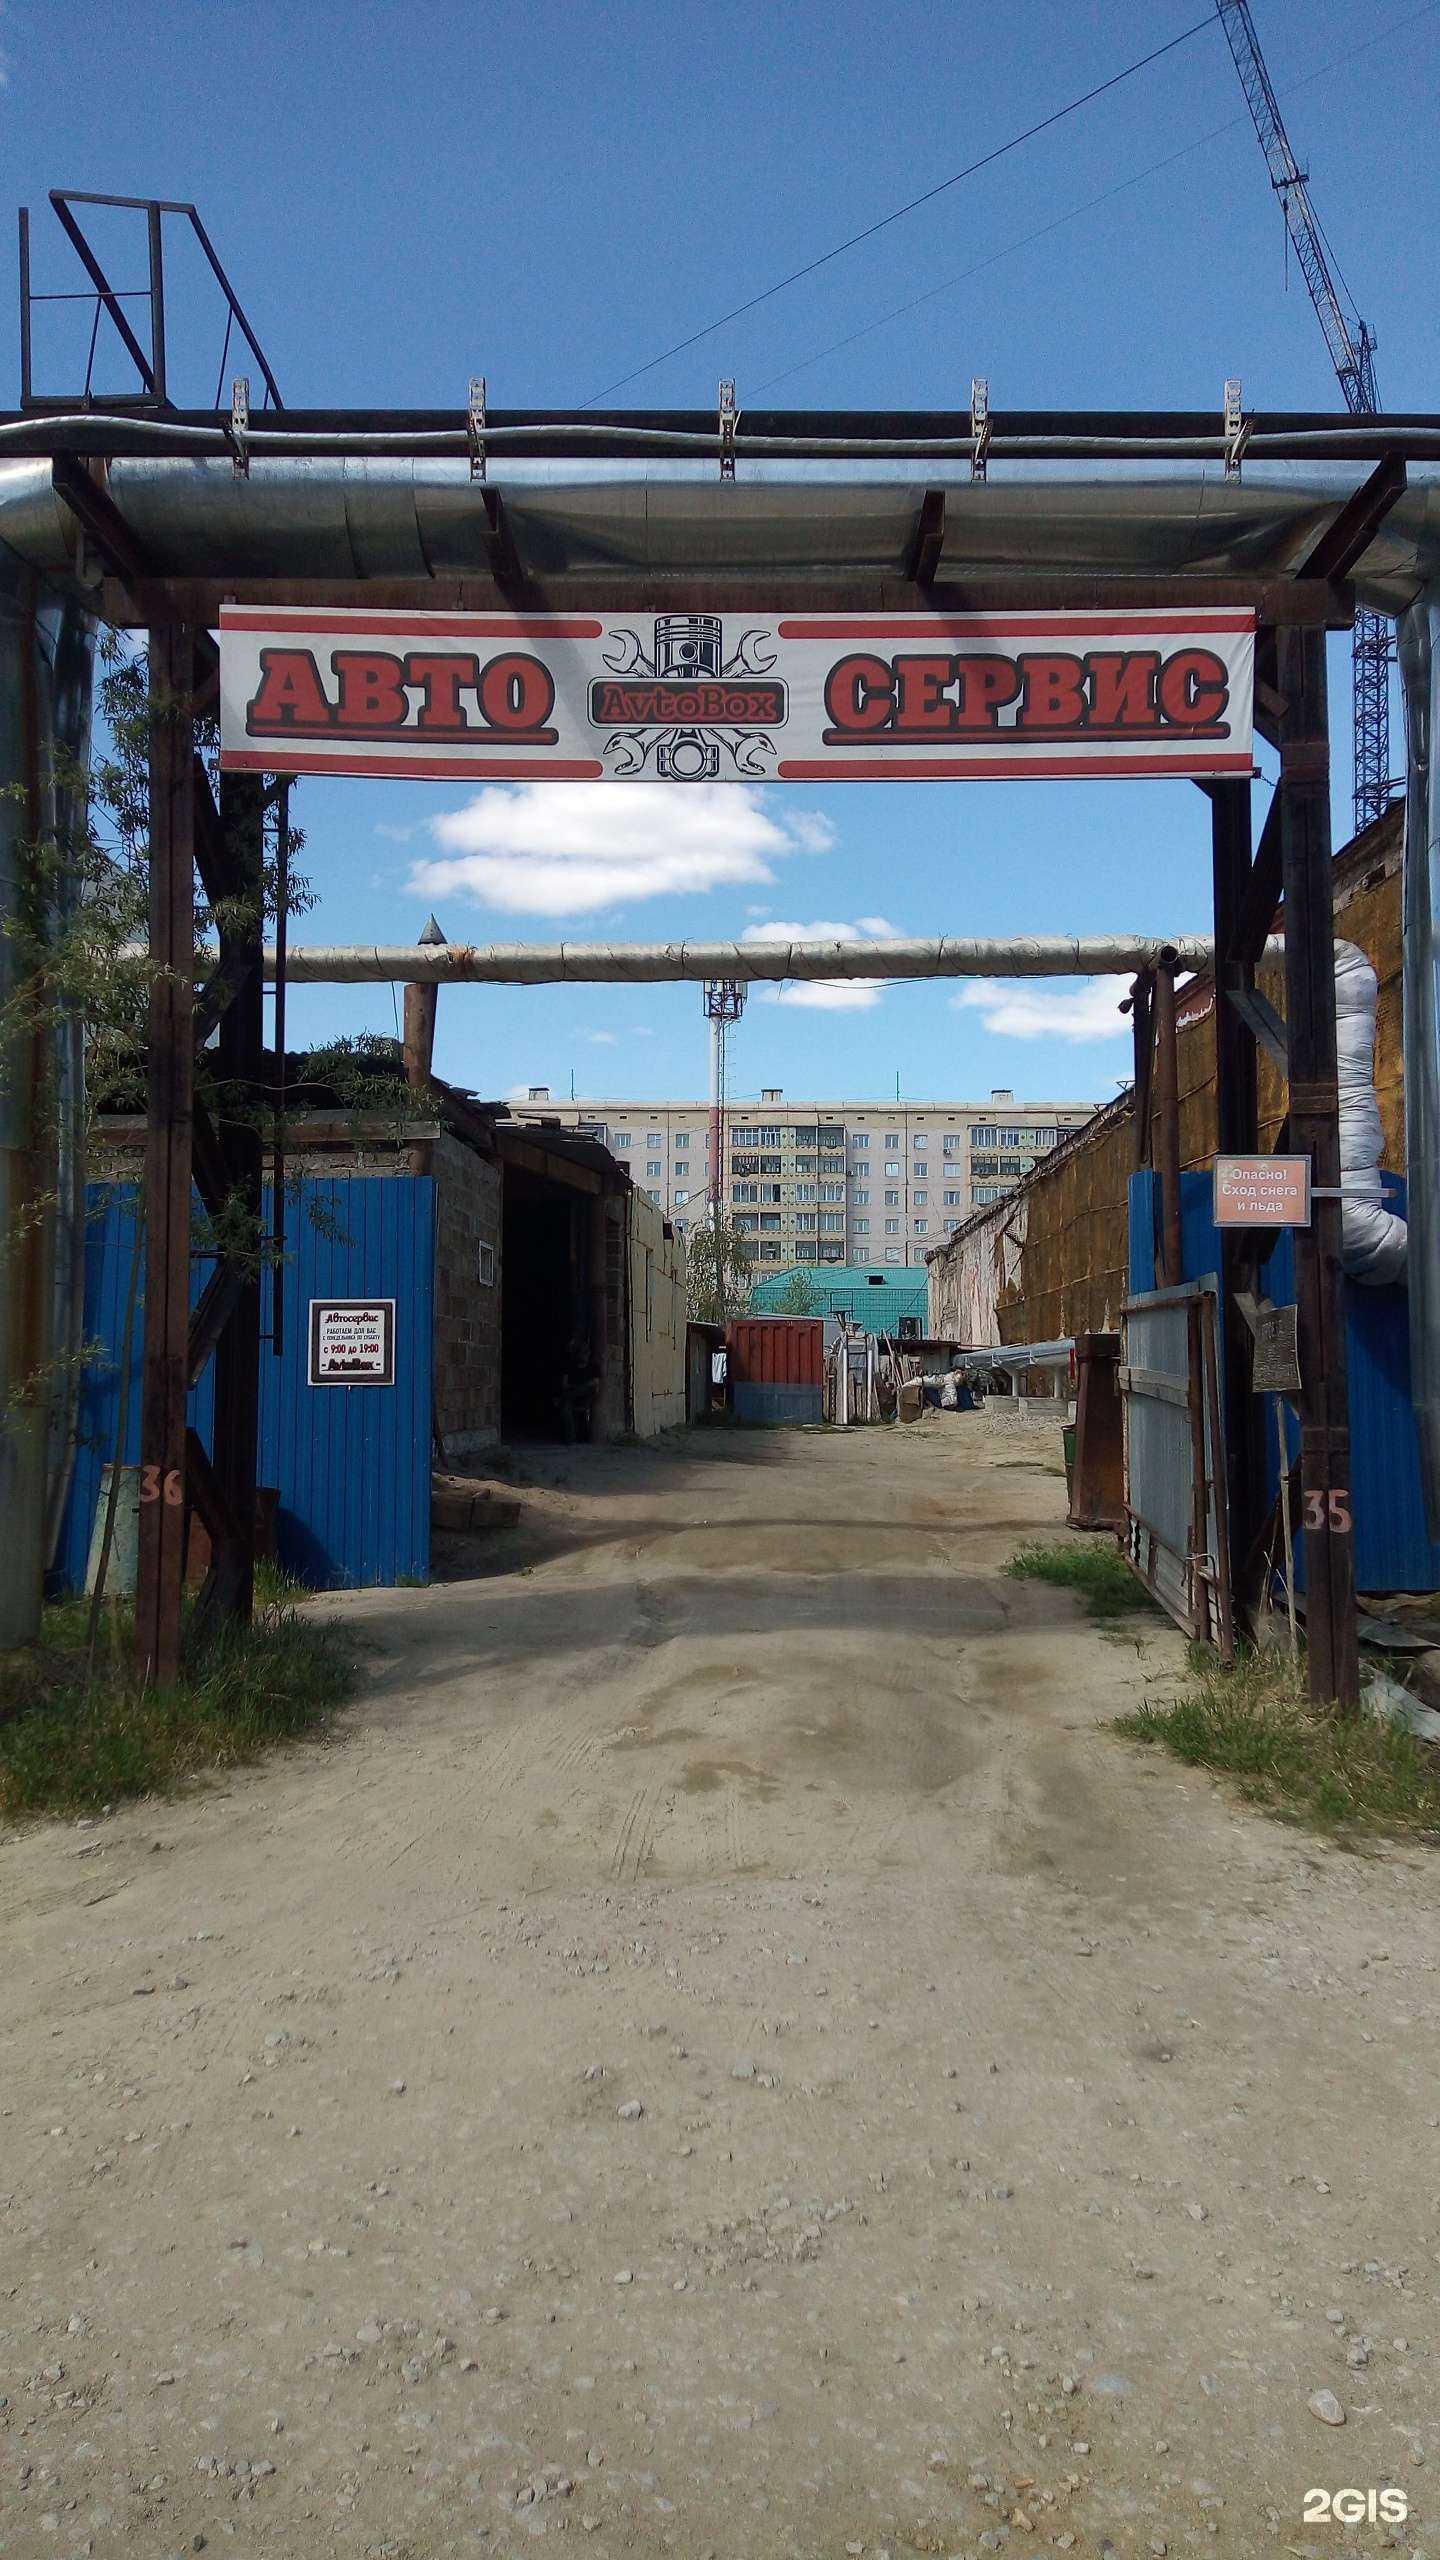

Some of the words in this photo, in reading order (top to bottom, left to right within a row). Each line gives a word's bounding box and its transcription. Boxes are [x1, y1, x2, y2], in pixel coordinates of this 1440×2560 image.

[247, 647, 556, 732] АВТО
[823, 648, 1230, 732] СЕРВИС
[602, 684, 778, 723] AvtoBox
[1231, 1168, 1287, 1180] Опасно!
[1222, 1183, 1257, 1197] Сход
[1260, 1186, 1298, 1196] снега
[1237, 1201, 1246, 1211] и
[1249, 1201, 1284, 1213] льда
[325, 1312, 379, 1325] Автосервис
[331, 1344, 346, 1354] 9:00
[360, 1343, 379, 1353] 19:00
[140, 1464, 184, 1506] 36
[1303, 1489, 1352, 1534] 35
